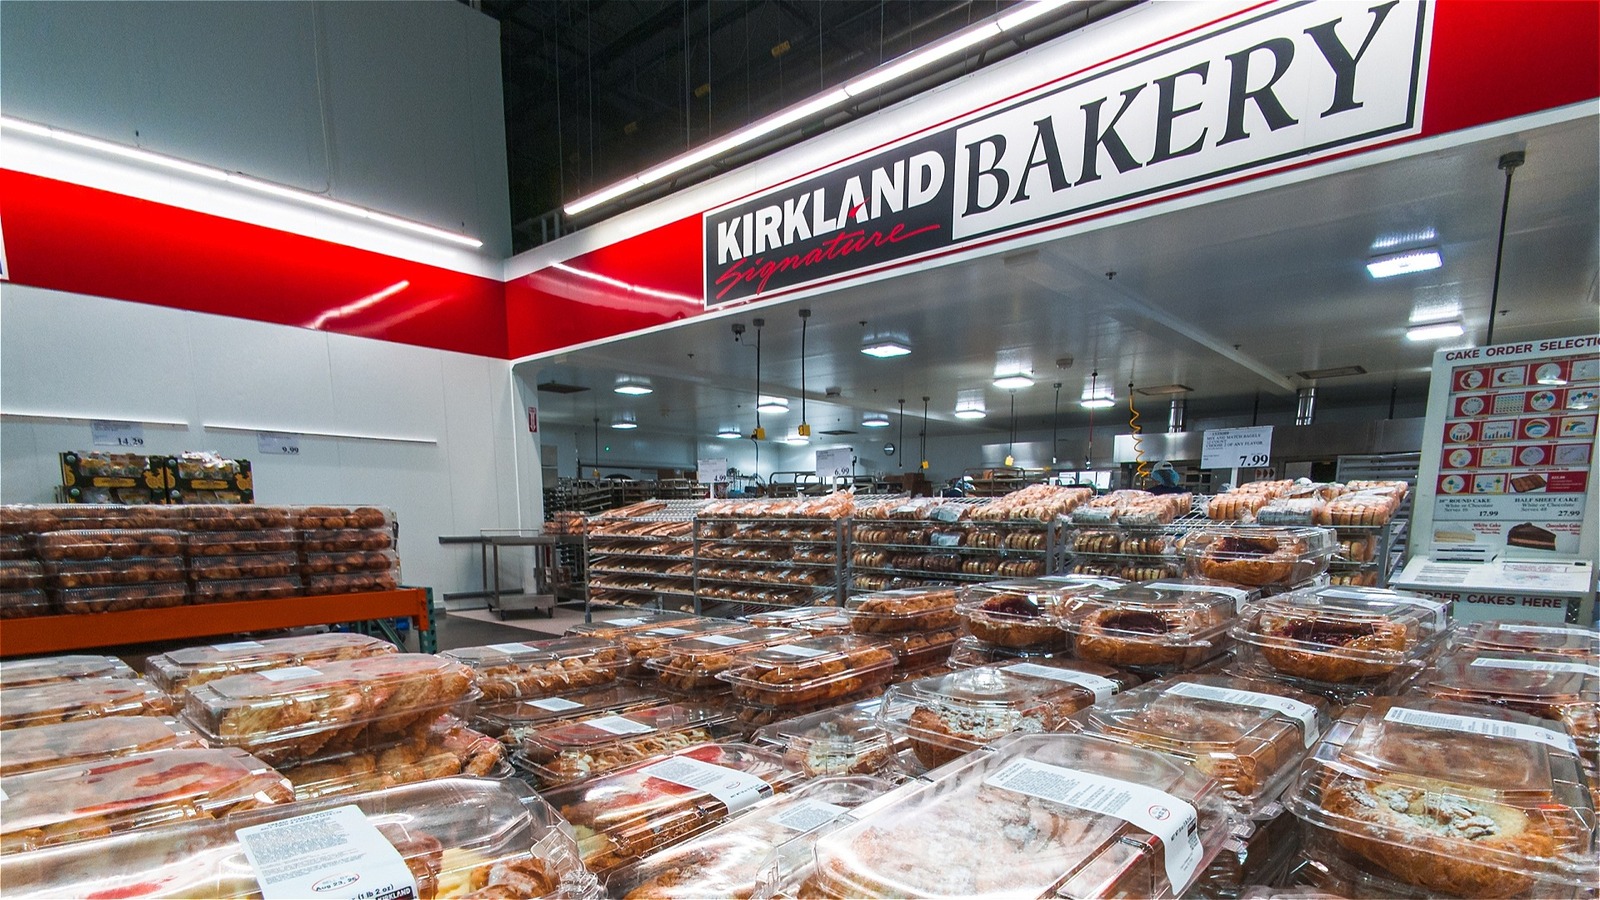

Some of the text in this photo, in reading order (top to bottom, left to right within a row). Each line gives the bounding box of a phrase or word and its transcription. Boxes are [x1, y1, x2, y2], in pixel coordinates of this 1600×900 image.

[961, 0, 1402, 219] BAKERY
[716, 149, 946, 265] KIRKLAND
[715, 221, 940, 300] Signature
[1445, 349, 1480, 361] CAKE
[1485, 344, 1533, 357] ORDER
[118, 437, 144, 446] 14.29
[282, 446, 299, 454] 9.99
[1239, 454, 1269, 467] 7.99
[834, 467, 850, 476] 6.99
[1467, 593, 1516, 606] CAKES
[1522, 596, 1562, 609] HERE
